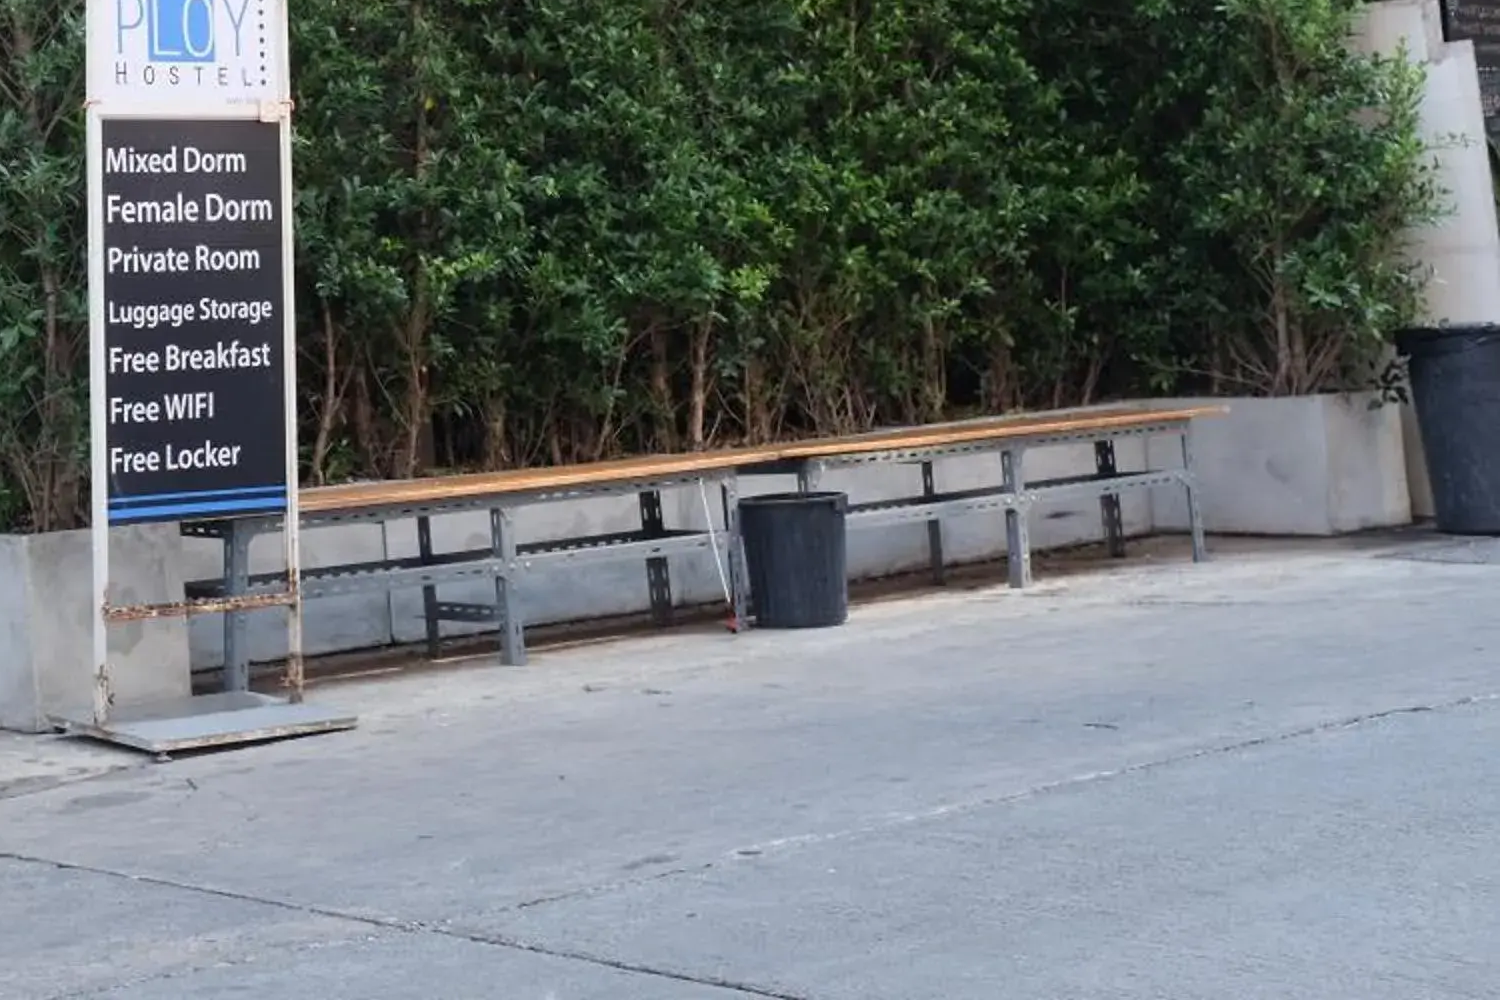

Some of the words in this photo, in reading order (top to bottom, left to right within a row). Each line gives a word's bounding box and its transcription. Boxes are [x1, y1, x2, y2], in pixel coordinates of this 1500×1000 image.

[115, 61, 253, 87] HOSTEL
[104, 146, 177, 174] Mixed
[182, 146, 247, 173] Dorm
[106, 192, 199, 224] Female
[204, 193, 273, 222] Dorm
[107, 245, 190, 274] Private
[194, 244, 261, 272] Room
[108, 299, 195, 329] Luggage
[199, 297, 273, 326] Storage
[108, 346, 159, 374] Free
[165, 340, 271, 371] Breakfast
[110, 396, 160, 425] Free
[164, 391, 214, 421] WIFI
[110, 446, 160, 474] Free
[165, 440, 241, 471] Locker
